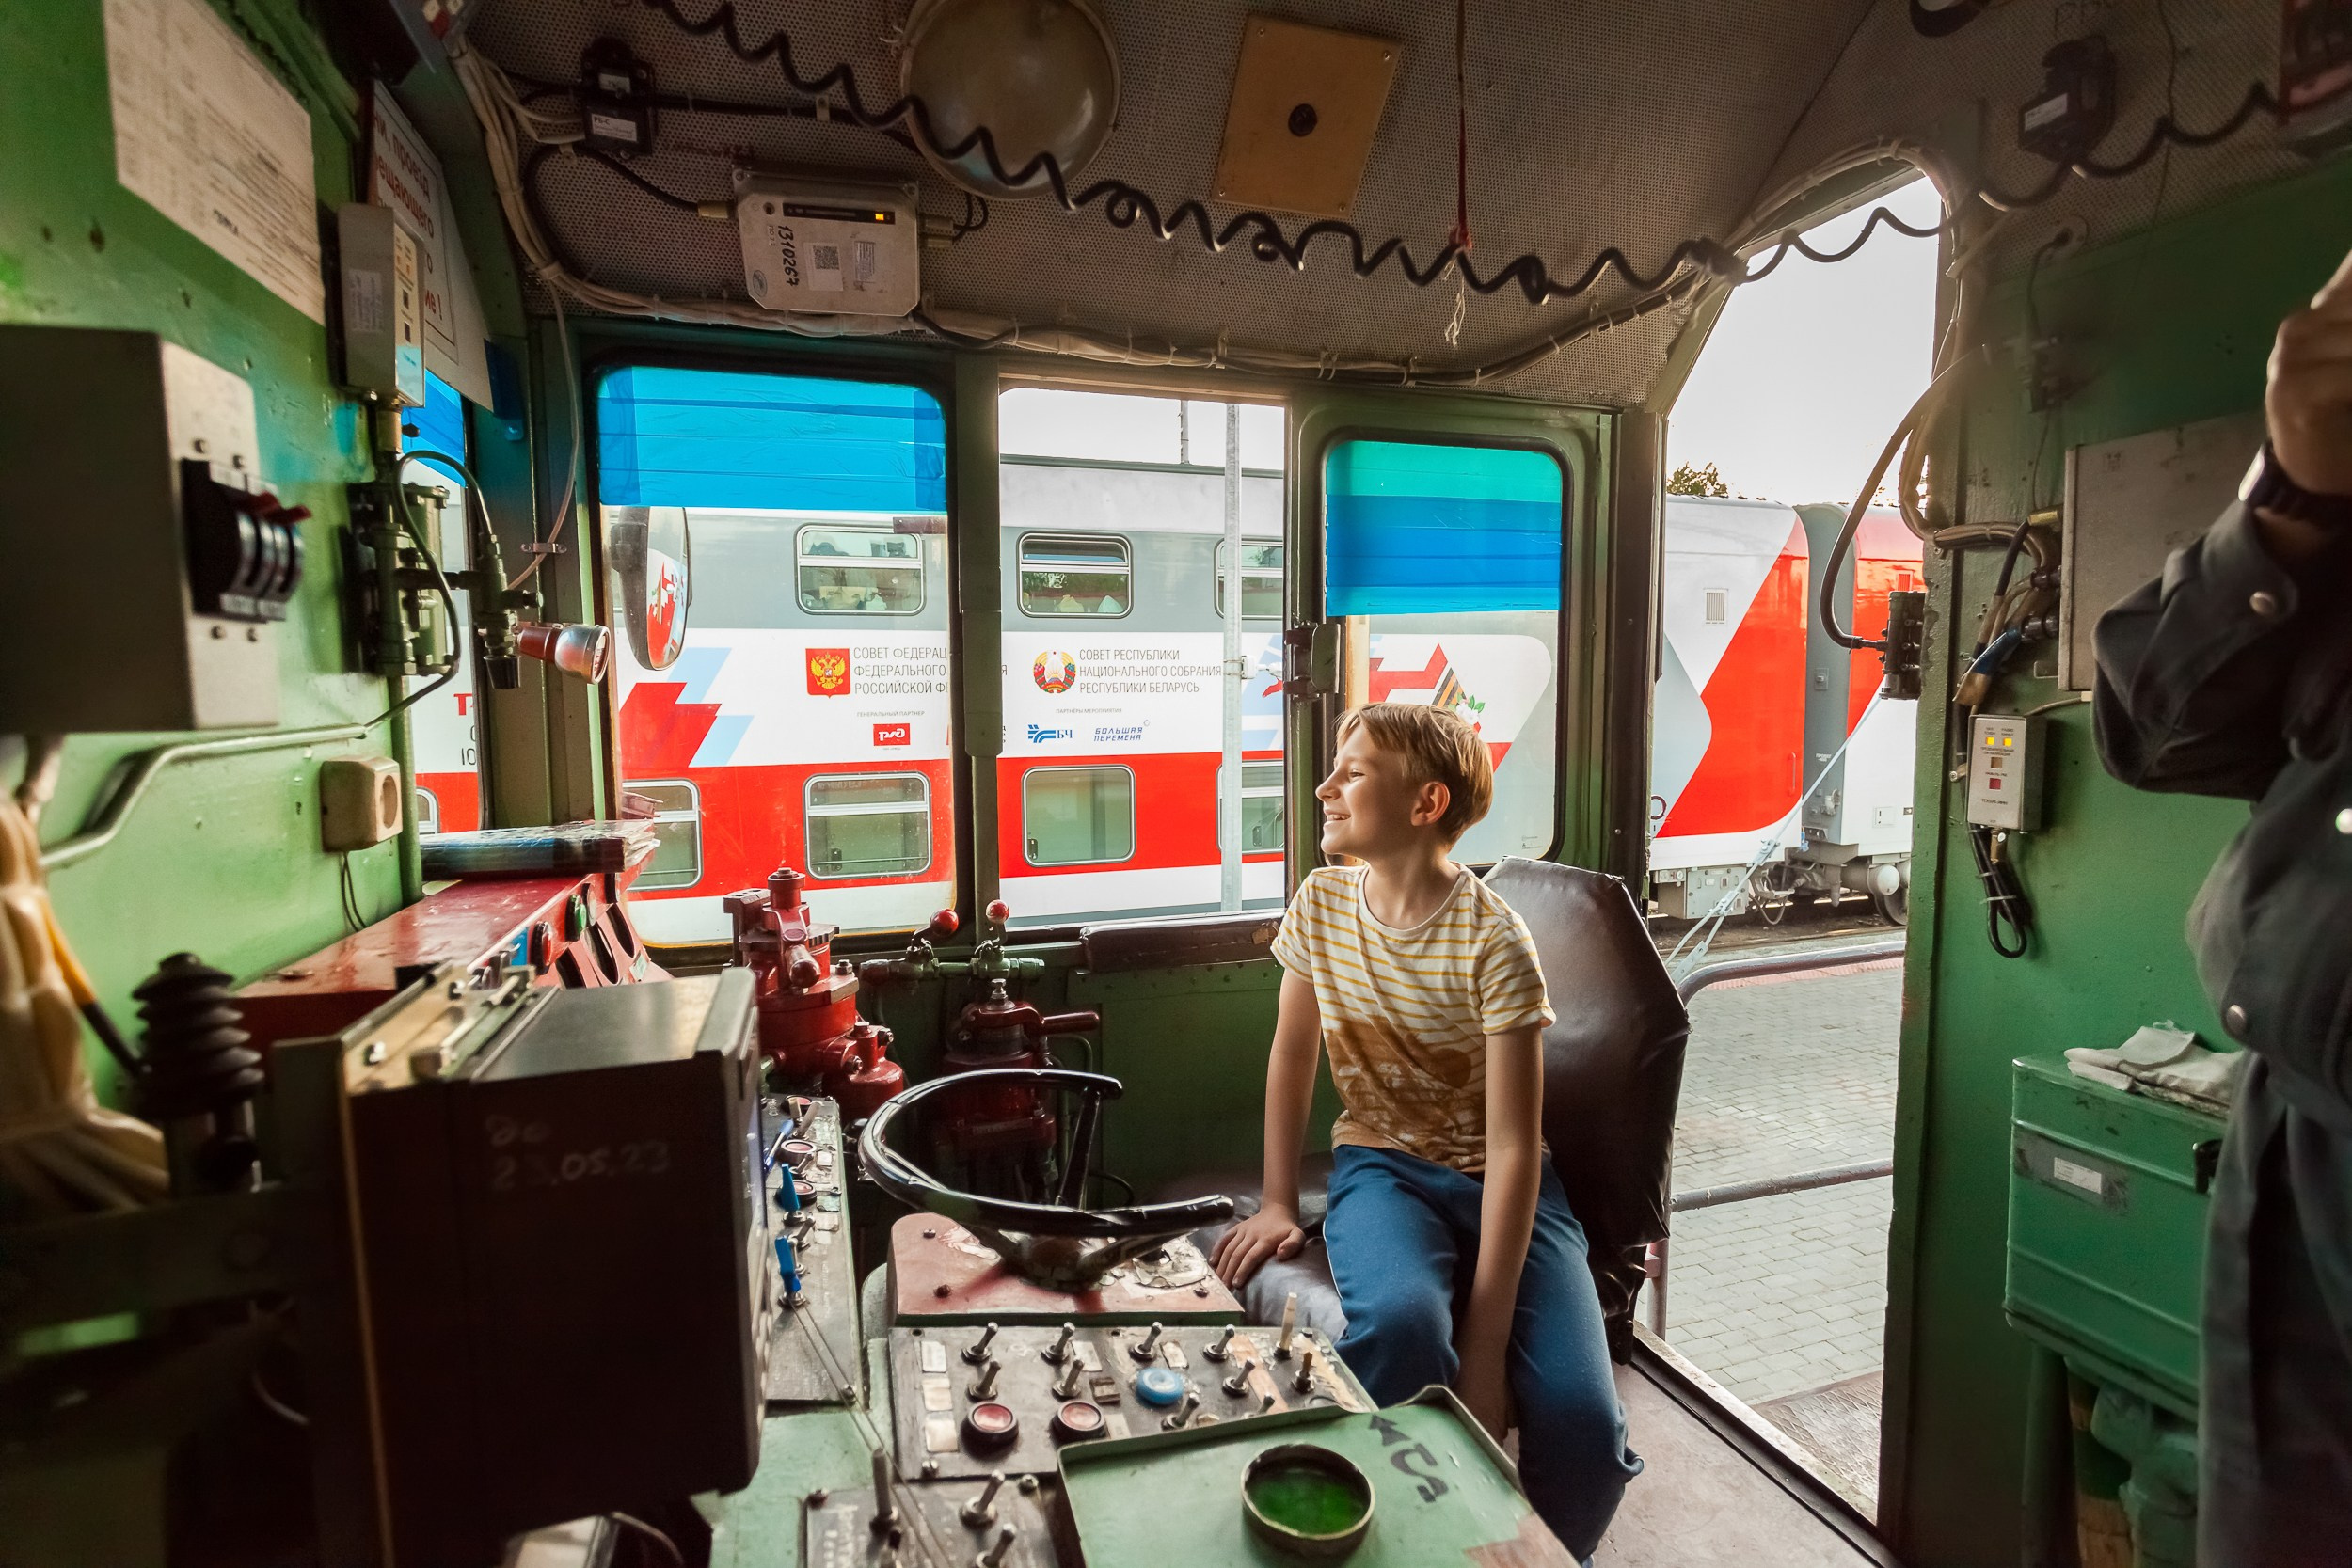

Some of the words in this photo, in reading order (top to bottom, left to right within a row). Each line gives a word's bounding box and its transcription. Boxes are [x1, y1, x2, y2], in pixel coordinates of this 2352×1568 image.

[376, 153, 435, 239] ещающего
[777, 225, 800, 287] 1310267
[853, 647, 888, 659] СОВЕТ
[1079, 649, 1110, 660] СОВЕТ
[1114, 649, 1180, 660] РЕСПУБЛИКИ
[854, 664, 946, 678] ФЕДЕРАЛЬНОГО
[1079, 665, 1168, 678] НАЦИОНАЛЬНОГО
[1170, 665, 1221, 677] СОБРАНИЯ
[855, 680, 932, 694] РОССИЙСКОЙ
[1080, 682, 1146, 694] РЕСПУБЛИКИ
[1149, 681, 1200, 693] БЕЛАРУСЬ
[1057, 729, 1073, 740] БЧ
[1094, 726, 1143, 735] БОЛЬШАЯ
[1093, 734, 1142, 742] ПЕРЕМЕНА
